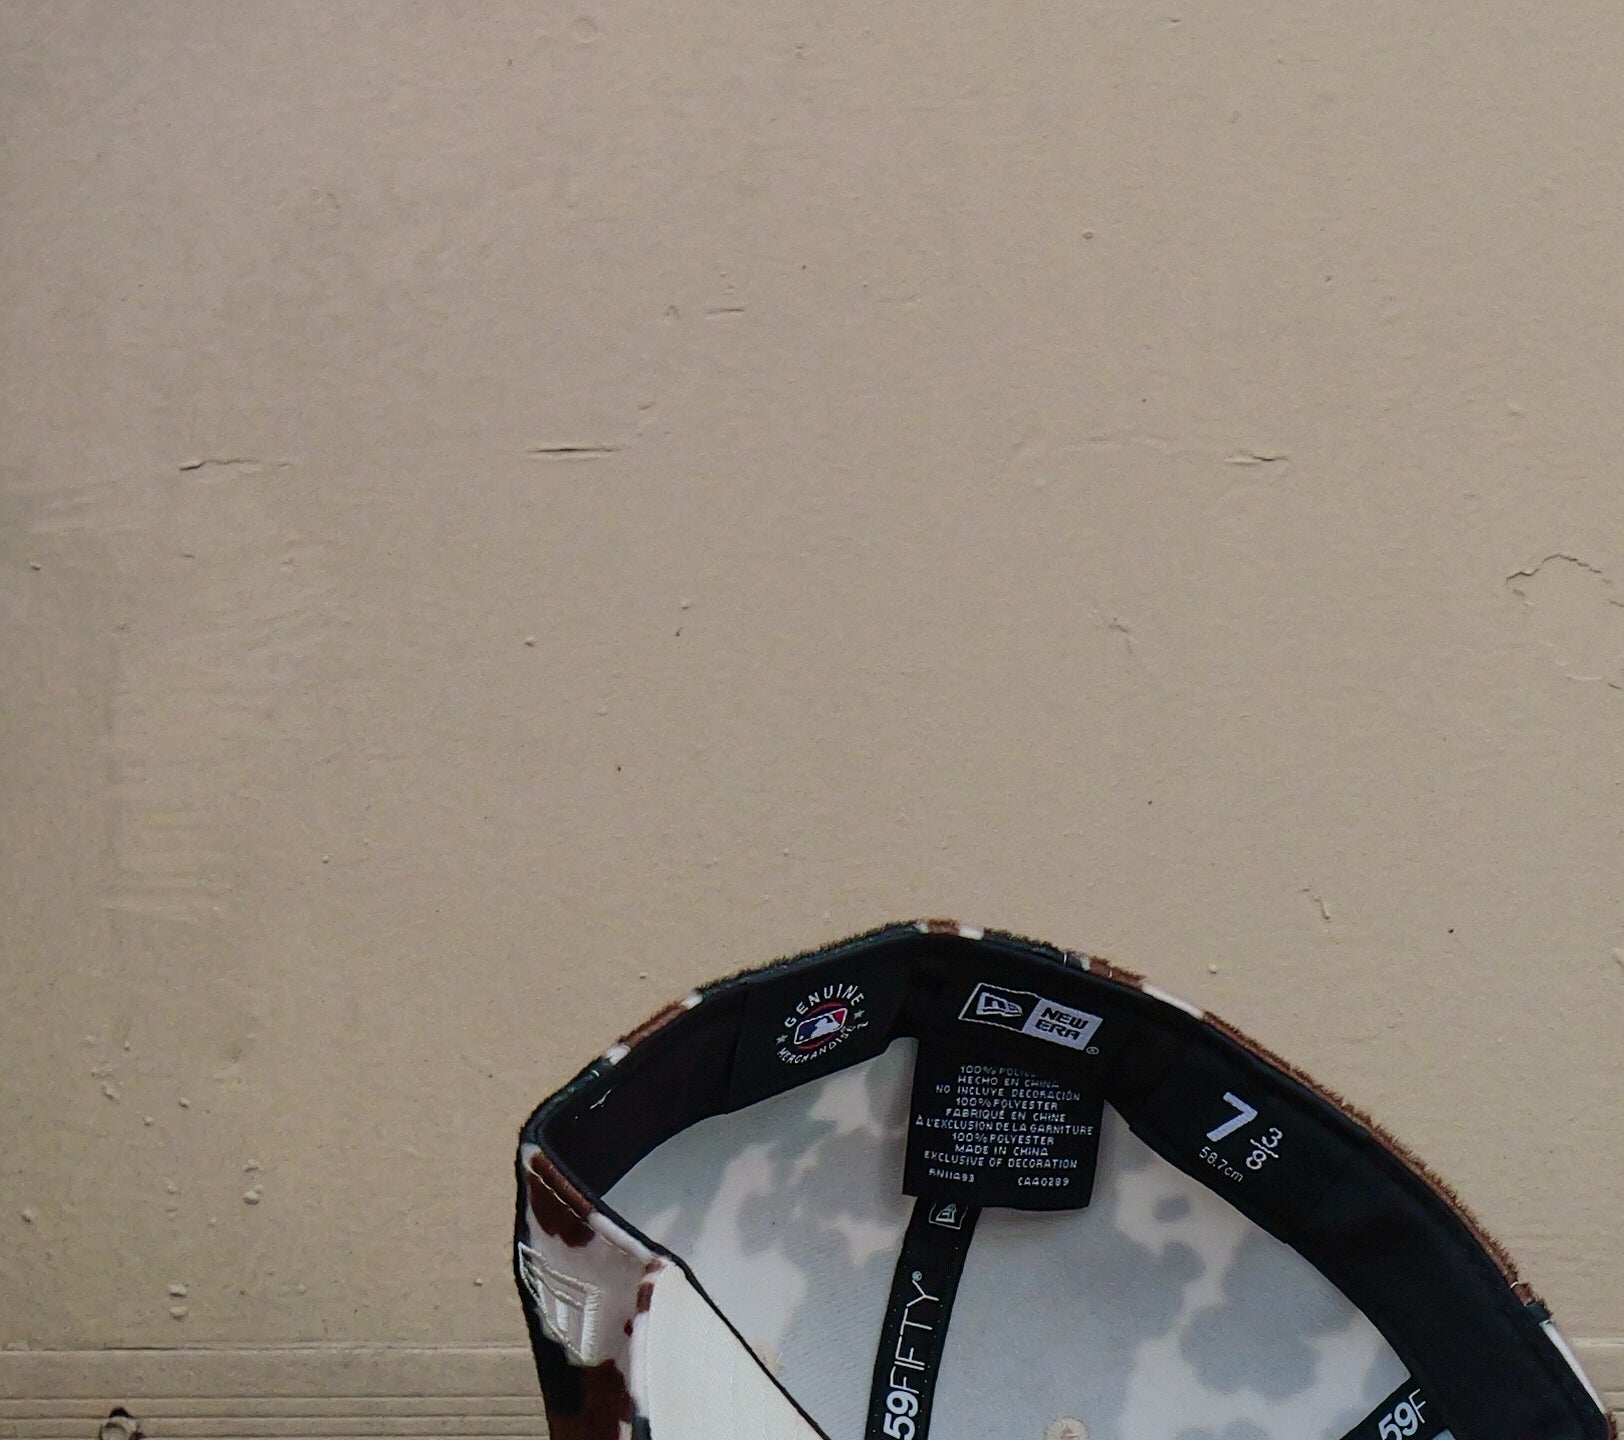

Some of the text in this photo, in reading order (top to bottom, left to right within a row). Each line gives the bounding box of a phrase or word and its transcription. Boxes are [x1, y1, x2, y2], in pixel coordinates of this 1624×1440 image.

[784, 983, 865, 1028] GENUINE
[1041, 1007, 1089, 1030] NEW
[1035, 1019, 1081, 1040] ERA
[935, 1084, 950, 1094] NO
[957, 1087, 1005, 1097] INCLUYE
[958, 1075, 998, 1086] HECHO
[1004, 1078, 1019, 1087] EN
[1011, 1112, 1026, 1121] EN
[1033, 1113, 1067, 1123] CHINE
[1206, 1091, 1258, 1142] 7
[1029, 1123, 1094, 1136] GARNITURE
[924, 1150, 1078, 1169] EXCLUSIVE OF DECORATION
[954, 1144, 1049, 1156] MADE IN CHINA
[1199, 1146, 1244, 1182] 58.7cm
